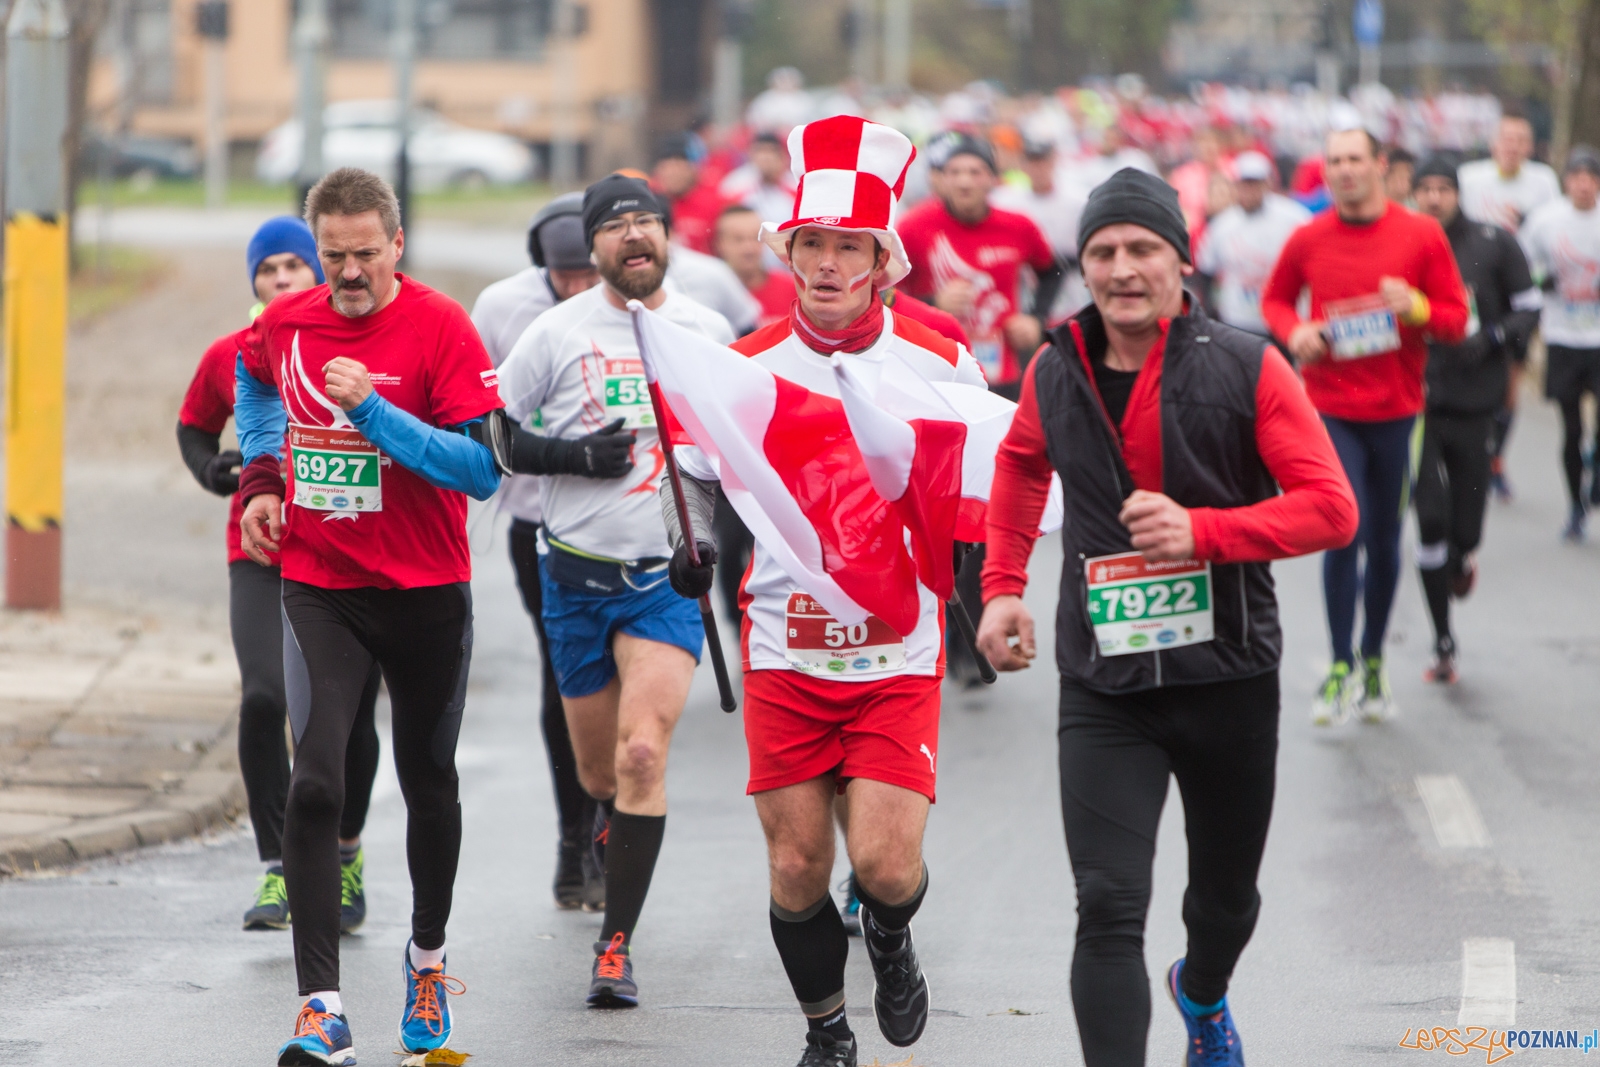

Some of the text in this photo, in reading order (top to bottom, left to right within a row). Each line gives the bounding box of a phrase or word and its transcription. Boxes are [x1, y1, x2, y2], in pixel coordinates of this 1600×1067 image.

[329, 438, 371, 448] RunPoland.org
[296, 453, 367, 484] 6927
[308, 485, 346, 495] Przemysław
[1100, 579, 1198, 622] 7922
[788, 622, 869, 648] B 50
